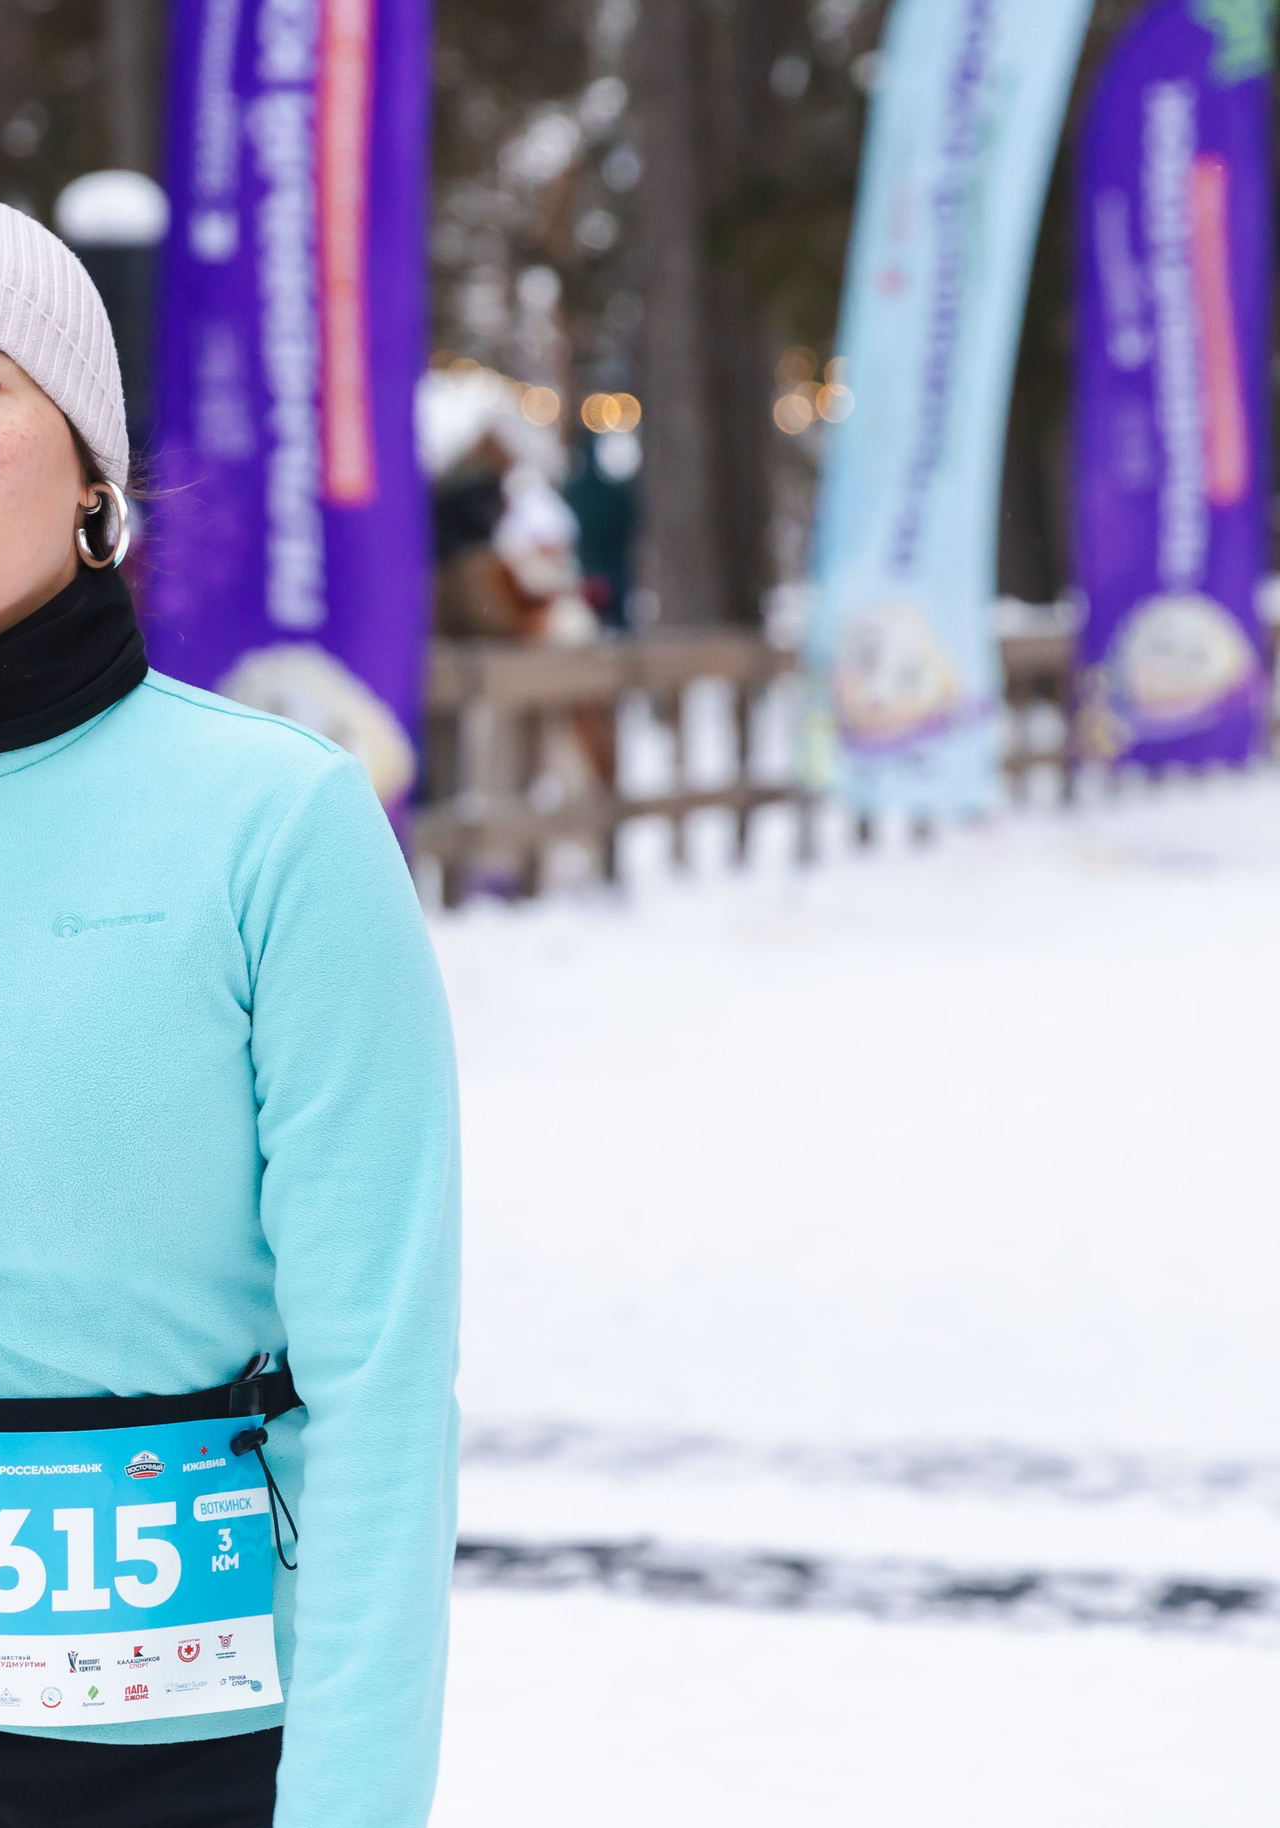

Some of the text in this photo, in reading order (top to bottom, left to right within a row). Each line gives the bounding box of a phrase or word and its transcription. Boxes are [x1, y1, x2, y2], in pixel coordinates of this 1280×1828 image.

[200, 1496, 253, 1515] ВОТКИНСК
[217, 1528, 233, 1552] 3
[211, 1552, 240, 1573] КМ
[0, 1660, 46, 1669] УДМУРТИИ
[116, 1656, 160, 1666] КАЛАШНИКОВ
[128, 1662, 149, 1670] СПОРТ
[228, 1674, 247, 1682] ТОЧКА
[124, 1684, 149, 1695] ПАПА
[124, 1693, 149, 1702] ДЖОНС
